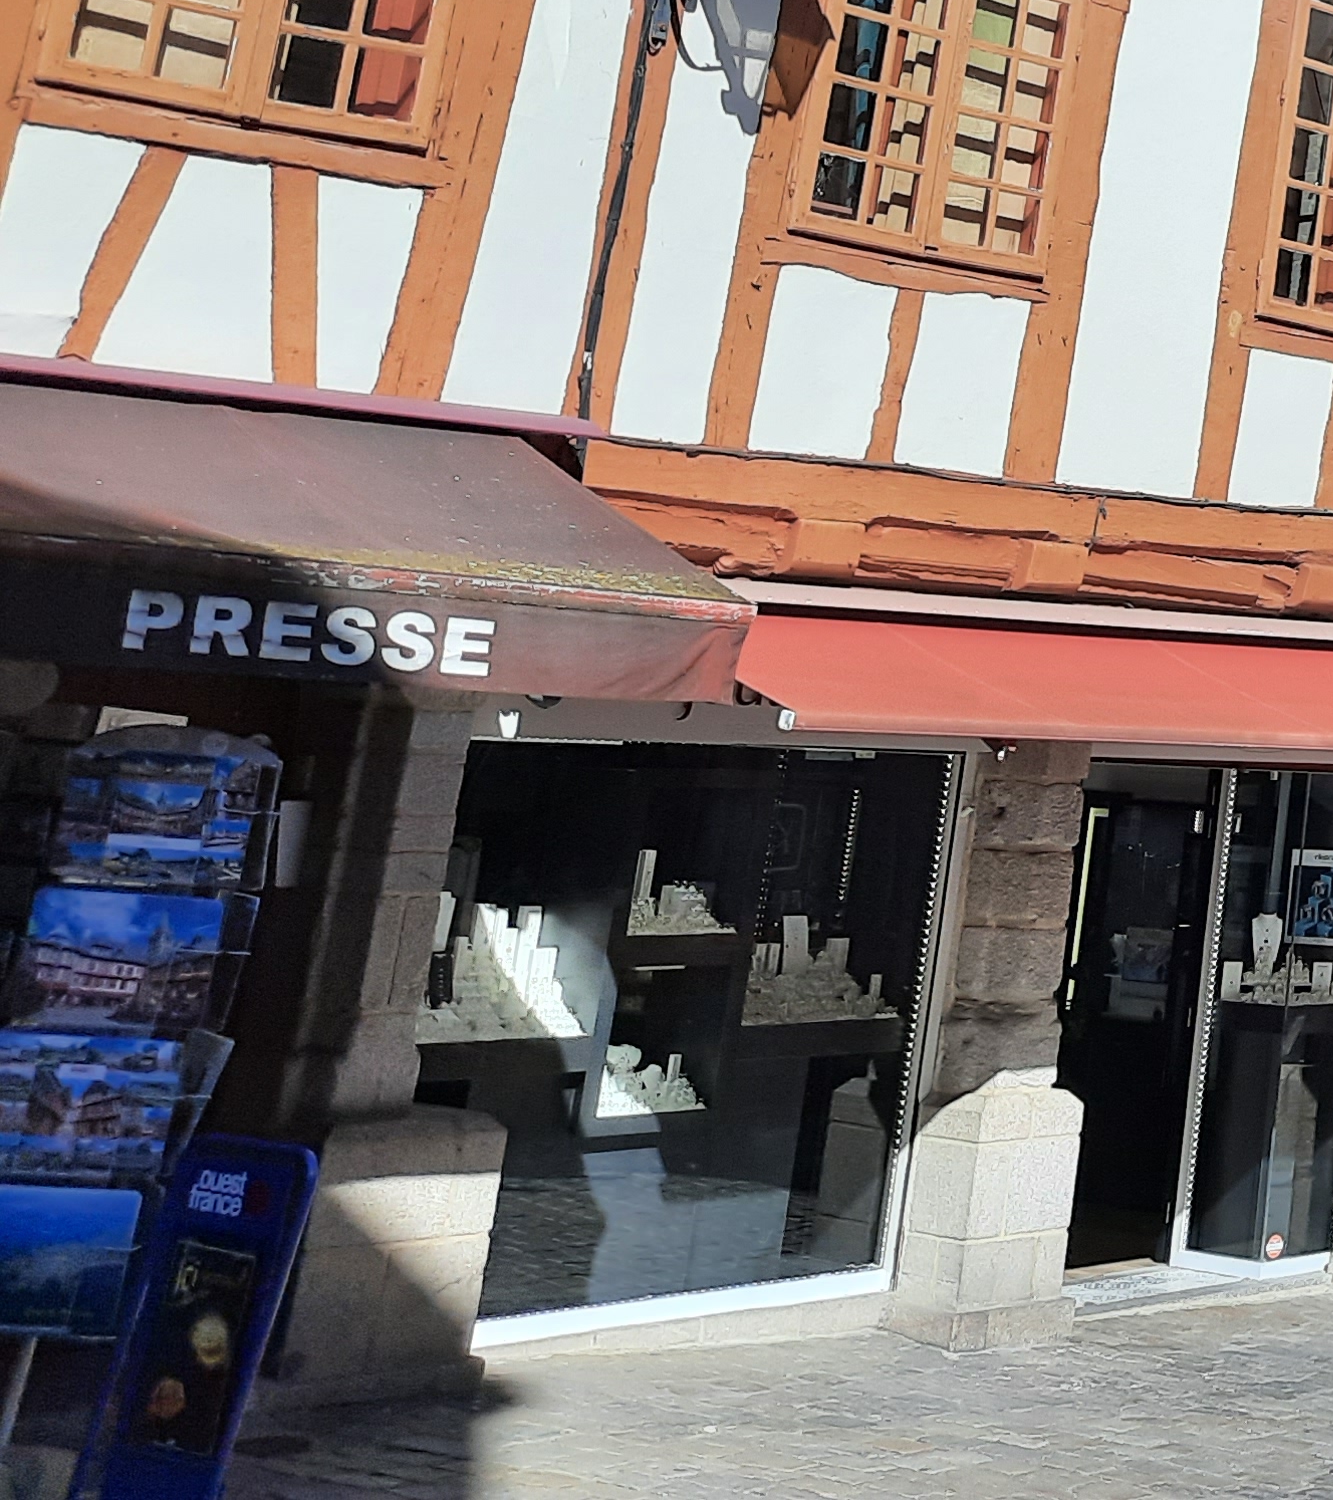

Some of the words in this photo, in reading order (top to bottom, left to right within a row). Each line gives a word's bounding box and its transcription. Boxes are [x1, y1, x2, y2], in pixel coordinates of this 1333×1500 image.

[121, 588, 497, 678] PRESSE
[188, 1183, 243, 1218] france
[200, 1169, 248, 1197] ouest
